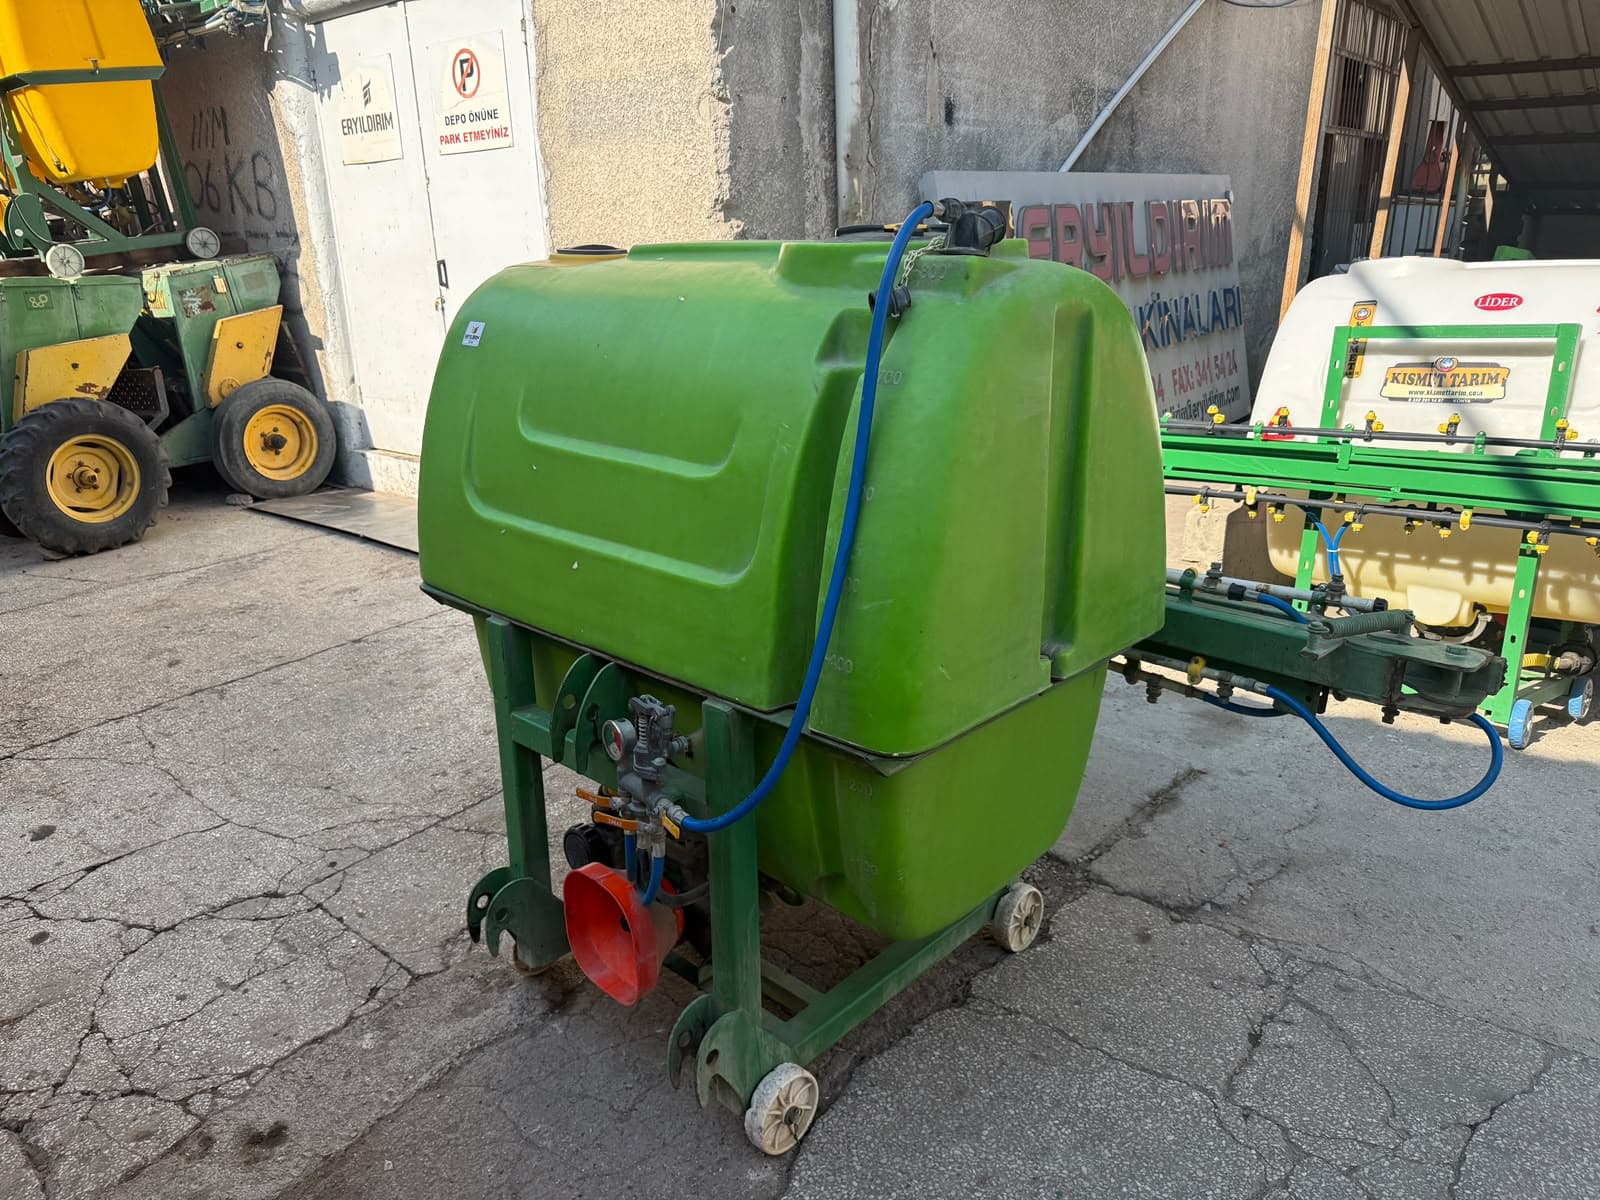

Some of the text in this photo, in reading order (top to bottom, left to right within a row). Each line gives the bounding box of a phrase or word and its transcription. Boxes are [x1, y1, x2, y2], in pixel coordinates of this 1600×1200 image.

[341, 112, 394, 136] ERYILDIRIM
[444, 108, 499, 127] DEPO ÖNÜNE
[439, 127, 509, 145] PARK ETMEYİNİZ
[1016, 199, 1233, 283] ERYILDIRIM
[1477, 296, 1519, 307] LİDER
[1171, 363, 1195, 397] FAX:
[1195, 355, 1213, 388] 341
[1449, 372, 1501, 387] TARIM
